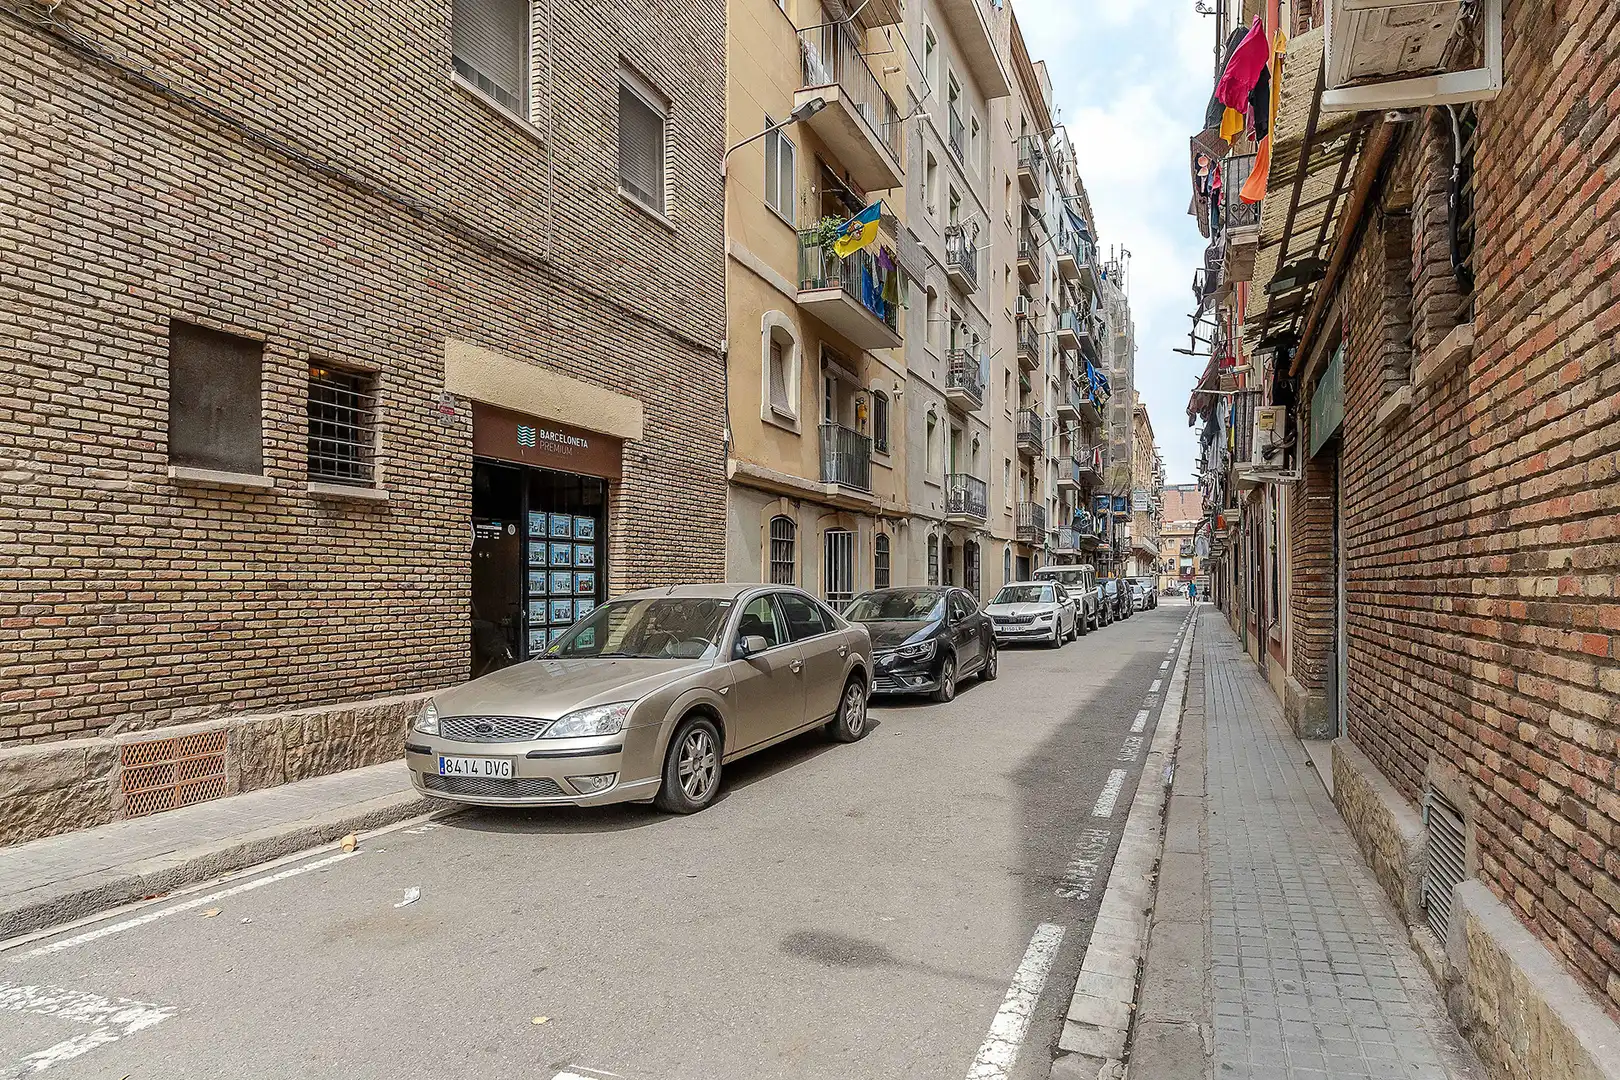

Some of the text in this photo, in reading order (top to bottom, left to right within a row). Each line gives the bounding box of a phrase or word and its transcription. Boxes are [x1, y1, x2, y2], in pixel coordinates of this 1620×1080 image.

[540, 430, 588, 448] BARCELONETA
[540, 440, 573, 456] PREMIUM
[446, 759, 509, 776] 8414 DVG
